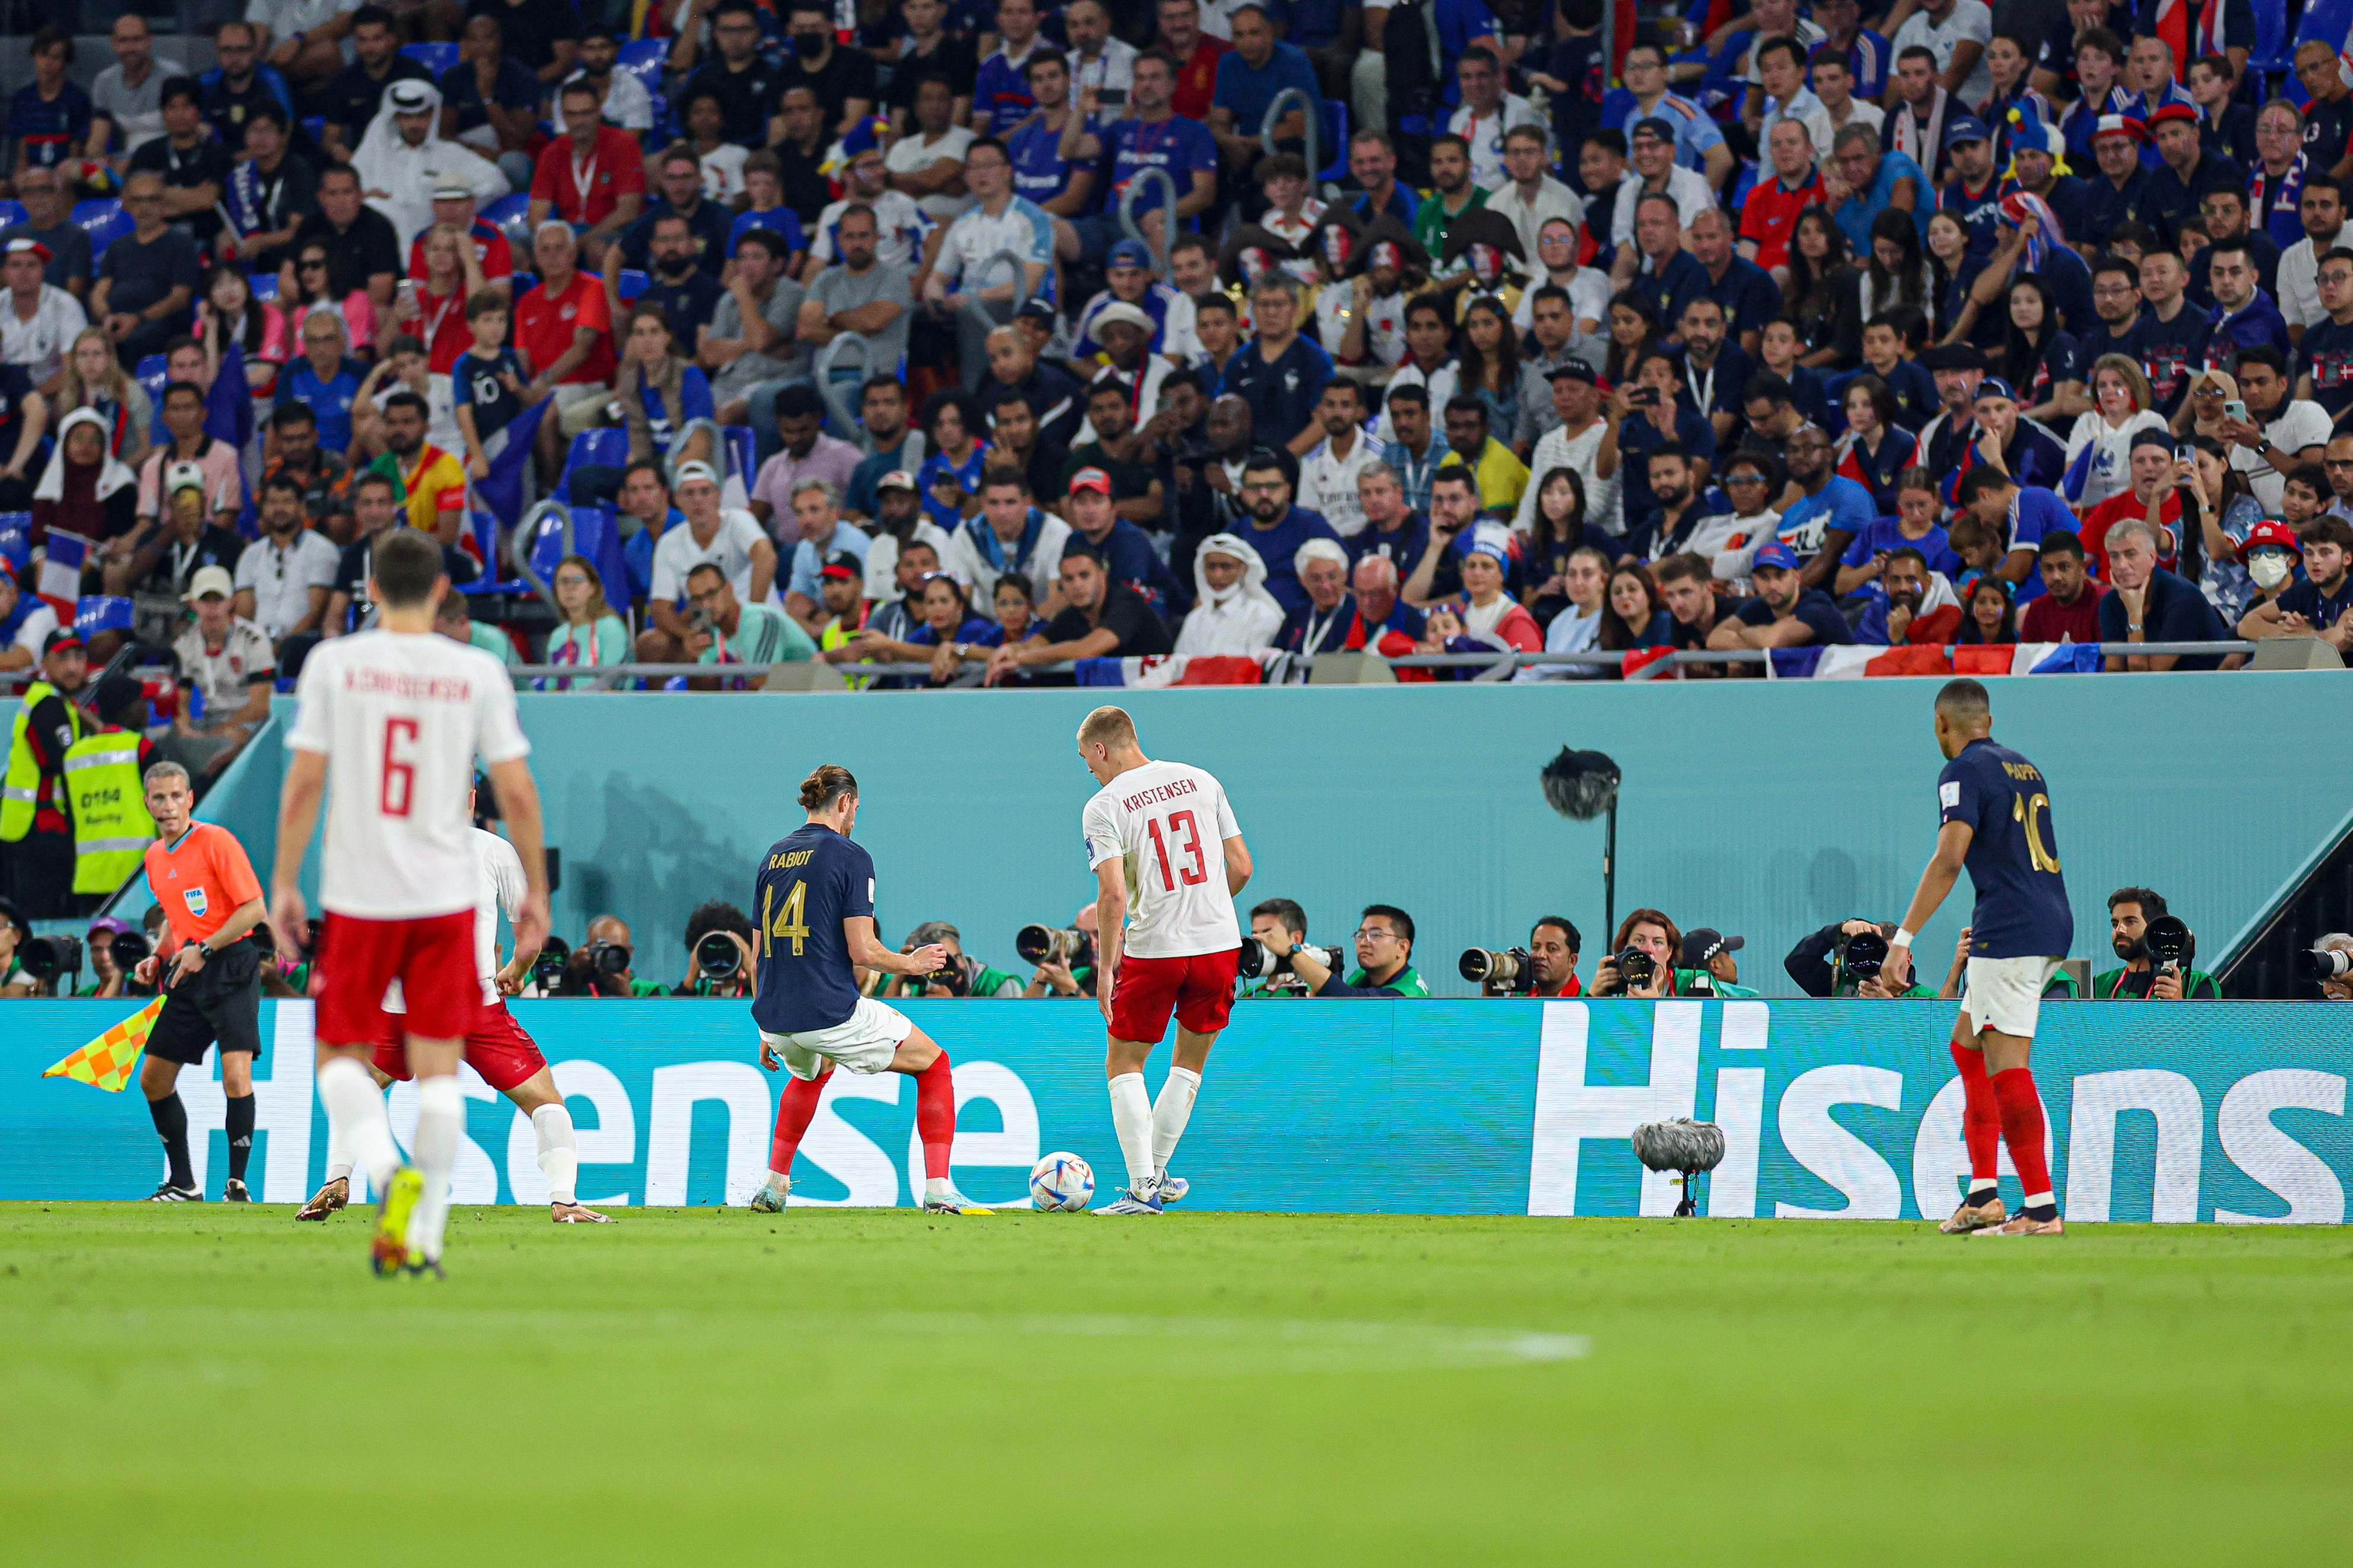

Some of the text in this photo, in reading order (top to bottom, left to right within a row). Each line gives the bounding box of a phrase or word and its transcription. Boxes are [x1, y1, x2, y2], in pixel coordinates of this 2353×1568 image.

[383, 715, 418, 818] 6
[1123, 779, 1198, 813] KRISTENSEN
[769, 850, 815, 870] RABIOT
[1148, 810, 1208, 892] 13
[186, 890, 202, 899] FIFA
[763, 879, 810, 958] 14
